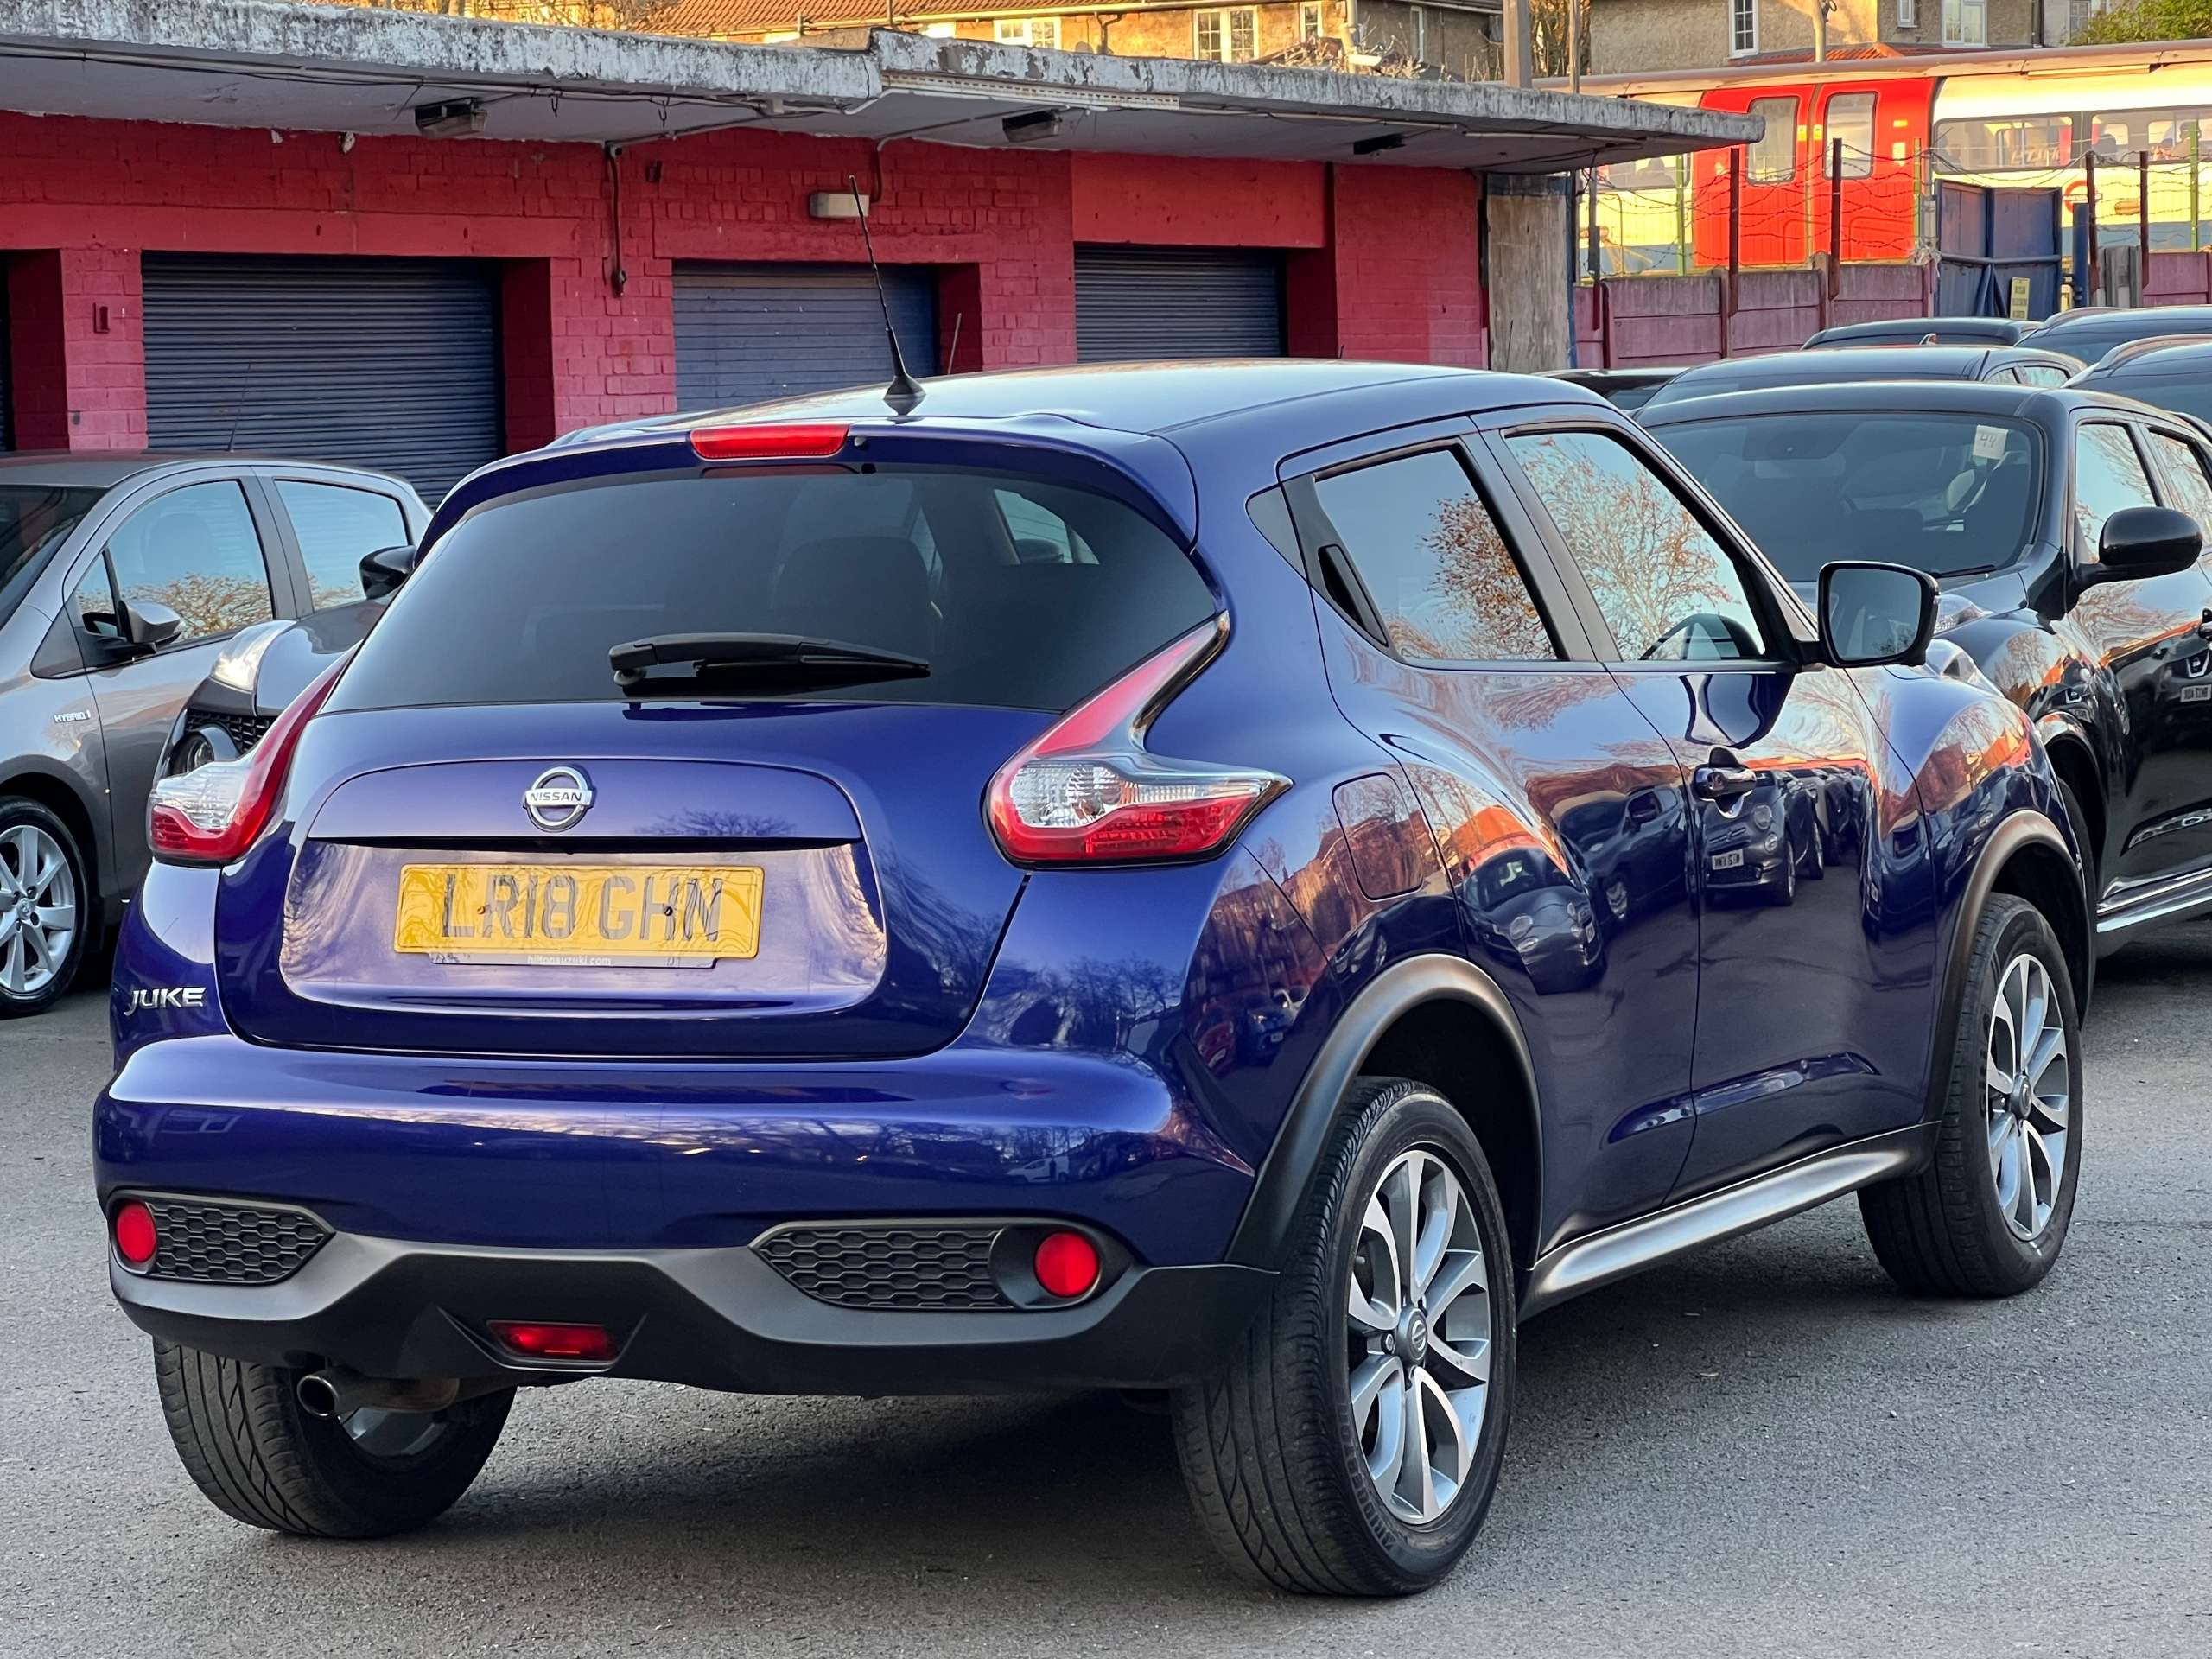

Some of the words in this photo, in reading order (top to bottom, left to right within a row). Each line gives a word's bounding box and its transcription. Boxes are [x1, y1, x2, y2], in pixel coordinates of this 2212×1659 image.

[1980, 434, 1998, 448] 44
[530, 791, 582, 803] NISSAN
[441, 873, 578, 940] LR18
[597, 874, 724, 942] GHN
[124, 986, 207, 1017] JUKE
